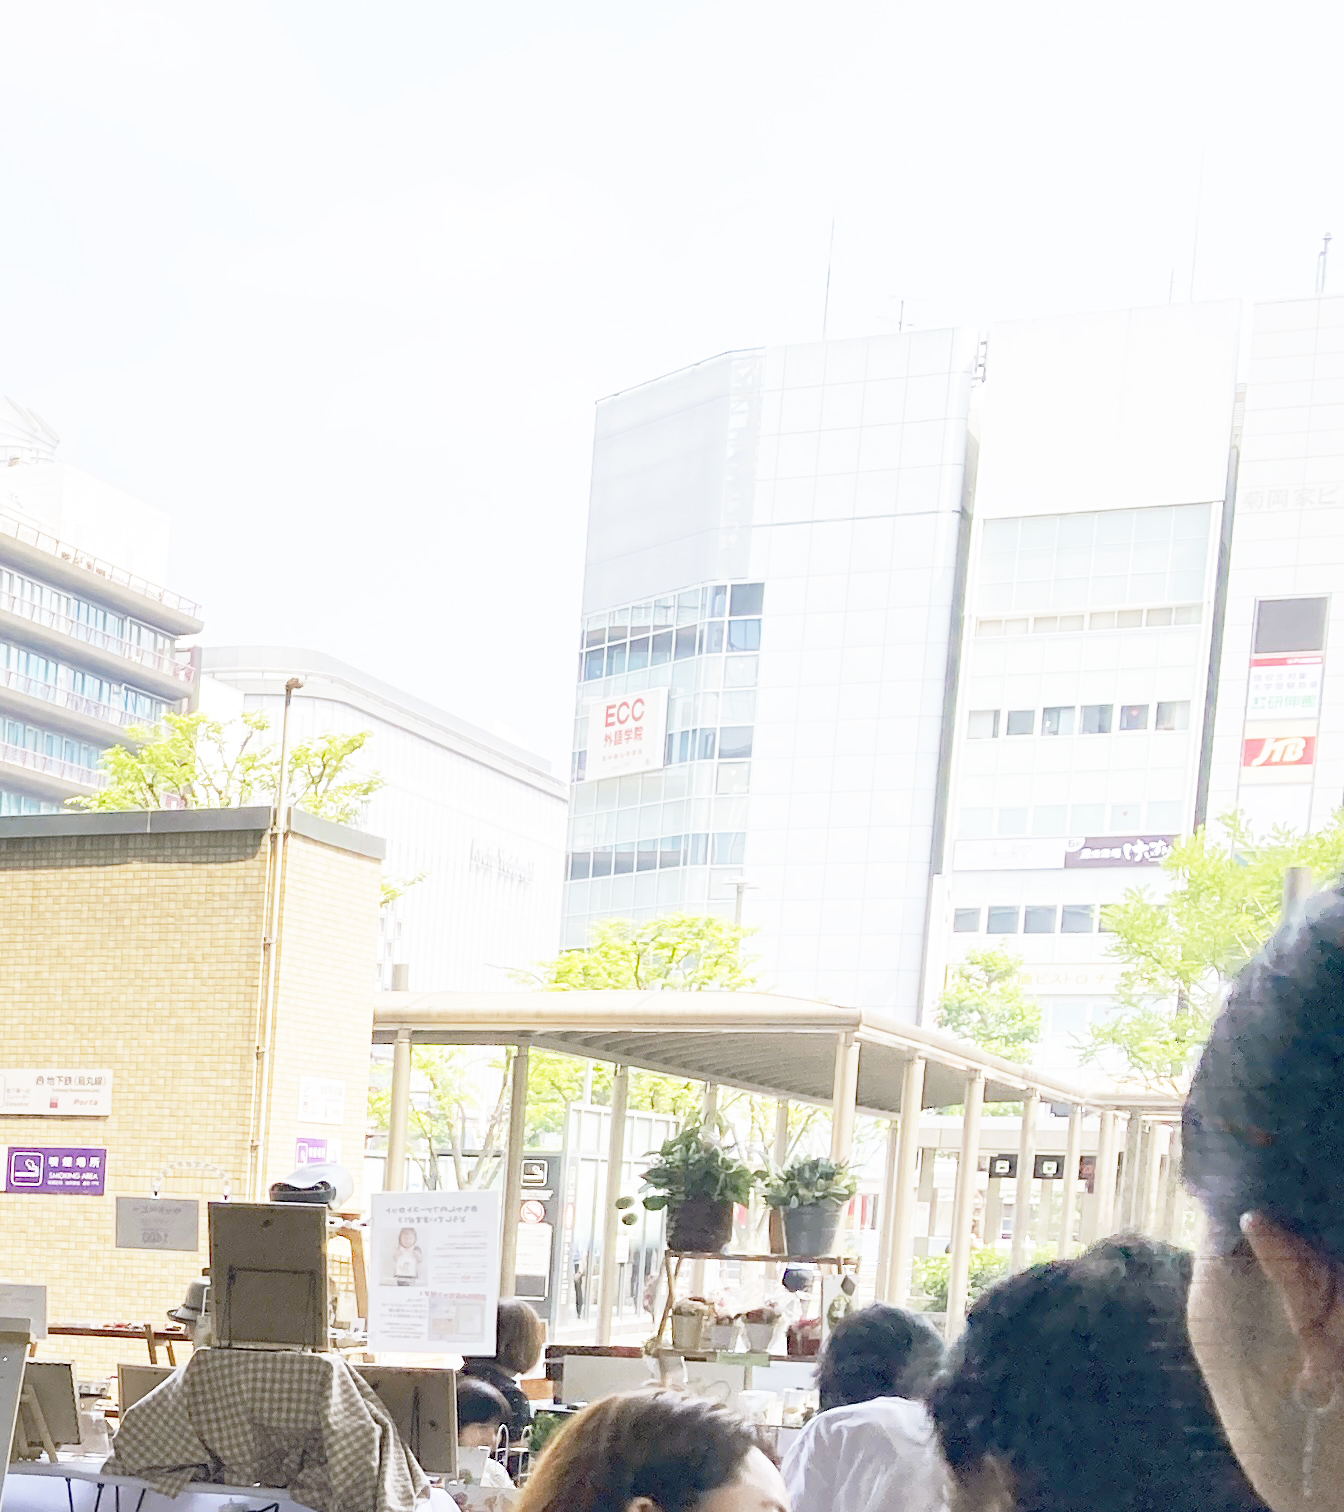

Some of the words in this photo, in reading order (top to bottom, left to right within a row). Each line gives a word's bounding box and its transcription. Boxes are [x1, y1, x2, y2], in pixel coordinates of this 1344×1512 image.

[1243, 485, 1344, 510] 菊岡家ビ
[604, 697, 646, 729] ECC
[603, 726, 644, 748] 外語学院
[1251, 736, 1307, 767] JTB
[73, 1098, 99, 1107] Porta
